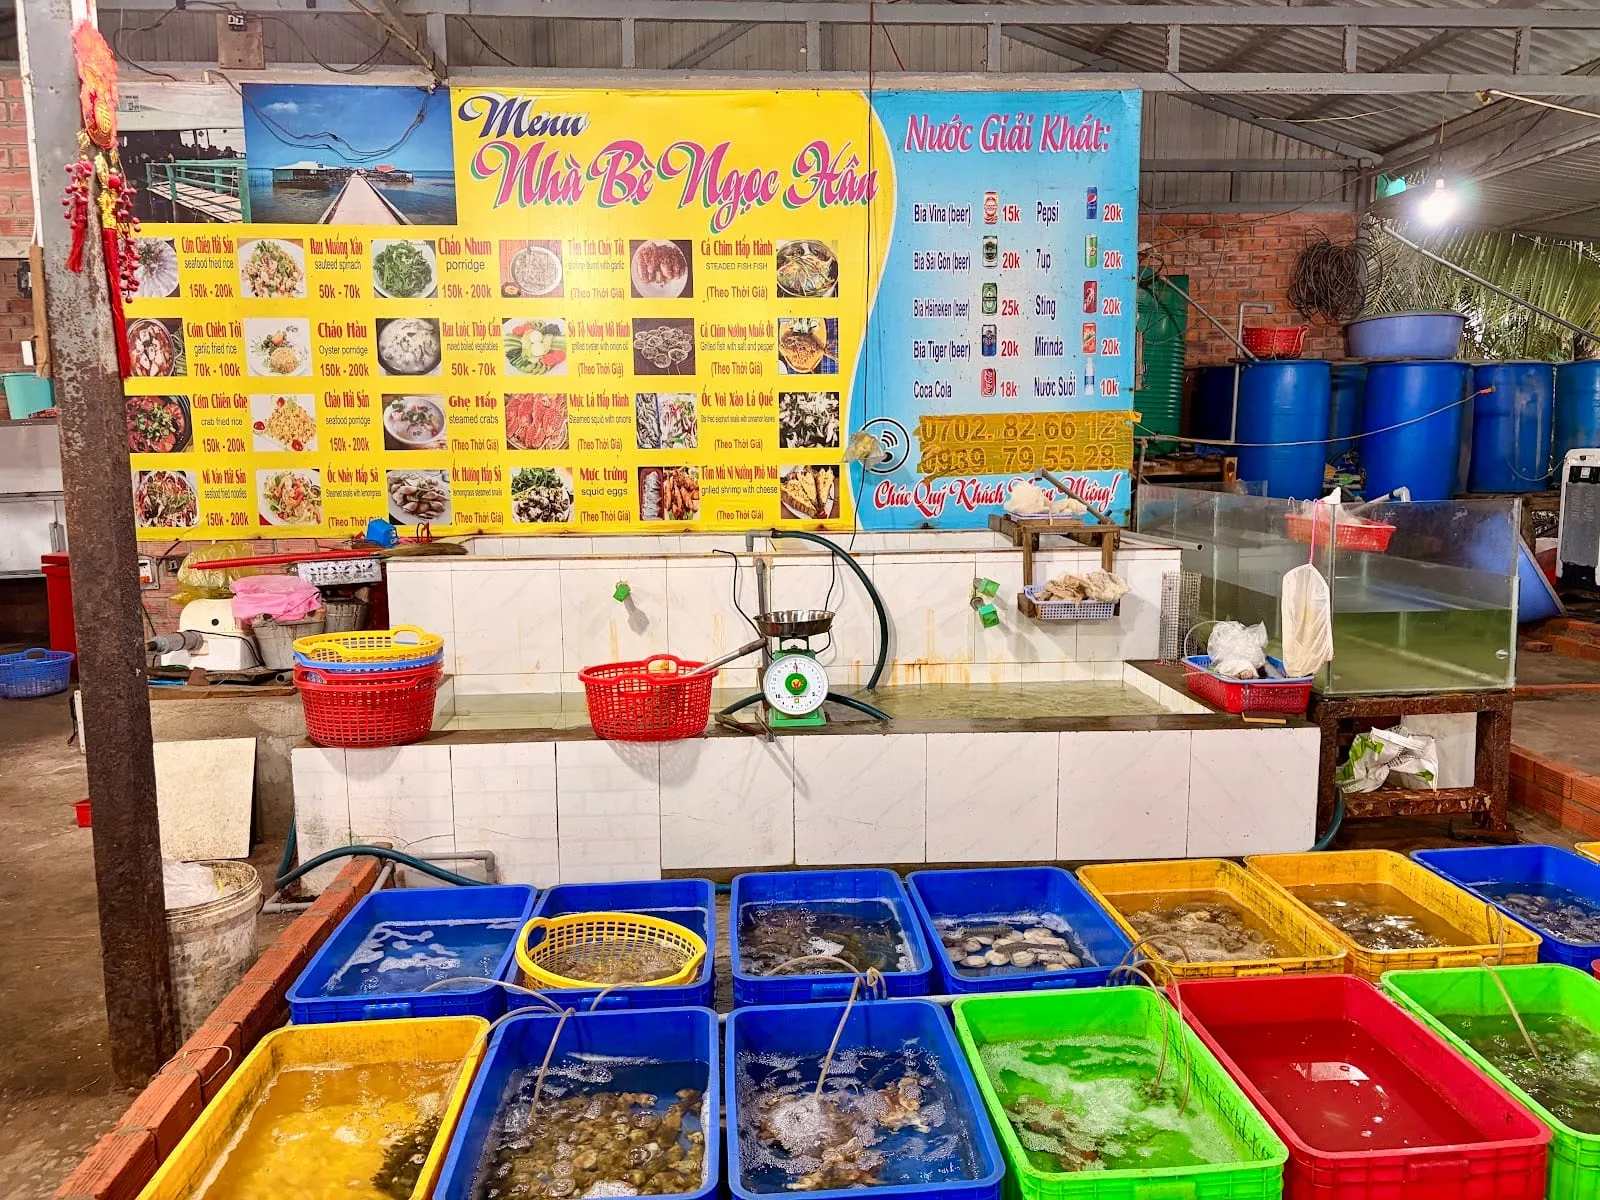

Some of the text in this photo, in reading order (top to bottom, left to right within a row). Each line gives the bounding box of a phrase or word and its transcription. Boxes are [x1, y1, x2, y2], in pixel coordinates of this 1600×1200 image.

[458, 92, 589, 138] Menu
[904, 112, 1112, 153] Nước Giải Khát:
[471, 140, 878, 234] Nhà Bè Ngọc Hân
[914, 204, 971, 228] Bia Vina (beer)
[1002, 204, 1020, 222] 15k
[1036, 201, 1059, 228] Pepsi
[1104, 204, 1122, 221] 20k
[310, 233, 362, 260] Rau Muống Xào
[438, 234, 492, 256] Cháo Nhum
[701, 234, 772, 258] Cá Chim Hấp Hành
[184, 257, 234, 268] seafood fried rice
[314, 259, 362, 272] sauteed spinach
[446, 258, 485, 272] porridge
[914, 252, 970, 276] Bia Sài Gòn (beer)
[1002, 252, 1020, 269] 20k
[1036, 248, 1051, 273] 7up
[1104, 252, 1122, 268] 20k
[190, 284, 234, 298] 150k 200k
[319, 284, 360, 298] 50k 70k
[442, 284, 492, 298] 150k 200k
[706, 286, 768, 300] (Theo Thời Giá)
[914, 299, 970, 320] Bia Heineken (beer)
[1002, 300, 1019, 316] 25k
[1036, 294, 1056, 320] Sting
[1103, 299, 1120, 314] 20k
[186, 320, 242, 338] Cơm Chiên Tỏi
[318, 320, 367, 338] Cháo Hàu
[194, 342, 238, 357] garlic fried rice
[319, 345, 368, 356] Oyster porridge
[914, 340, 970, 362] Bia Tiger (beer)
[1002, 341, 1019, 357] 20k
[1034, 336, 1064, 356] Mirinda
[1102, 340, 1120, 355] 20k
[194, 363, 240, 376] 70k 100k
[320, 363, 370, 376] 150k 200k
[452, 363, 496, 376] 50k 70k
[578, 362, 624, 377] (Theo Thời Giá)
[711, 361, 762, 378] (Theo Thời Giá)
[914, 380, 952, 398] Coca Cola
[1000, 382, 1018, 397] 18k
[1034, 372, 1076, 396] Nước Suối
[1101, 380, 1118, 396] 10k
[193, 392, 248, 414] Cơm Chiên Ghẹ
[324, 388, 370, 408] Cháo Hải Sản
[448, 391, 497, 412] Ghẹ Hấp
[201, 416, 243, 426] crab fried rice
[326, 415, 370, 427] seafood porridge
[448, 414, 498, 424] steamed crabs
[1003, 413, 1036, 442] 82
[1042, 412, 1077, 441] 66
[1085, 412, 1117, 441] 12
[202, 438, 246, 452] 150k 200k
[330, 437, 370, 452] 150k 200k
[452, 438, 499, 453] (Theo Thời Giá)
[578, 438, 623, 452] (Theo Thời Giá)
[714, 438, 764, 452] (Theo Thời Giá)
[1002, 446, 1036, 474] 79
[1042, 445, 1076, 473] 55
[1082, 444, 1116, 472] 28
[580, 466, 628, 484] Mực trứng
[581, 487, 628, 498] squid eggs
[702, 485, 778, 496] grilled shrimp with cheese
[874, 478, 912, 510] Chúc
[914, 476, 948, 519] Quý
[949, 477, 1006, 512] Khách
[206, 512, 248, 526] 150k 200k
[328, 516, 348, 528] (Theo
[350, 516, 366, 526] Thời
[454, 512, 504, 526] (Theo Thời Giá)
[580, 510, 630, 524] (Theo Thời Giá)
[716, 510, 764, 522] (Theo Thời Giá)
